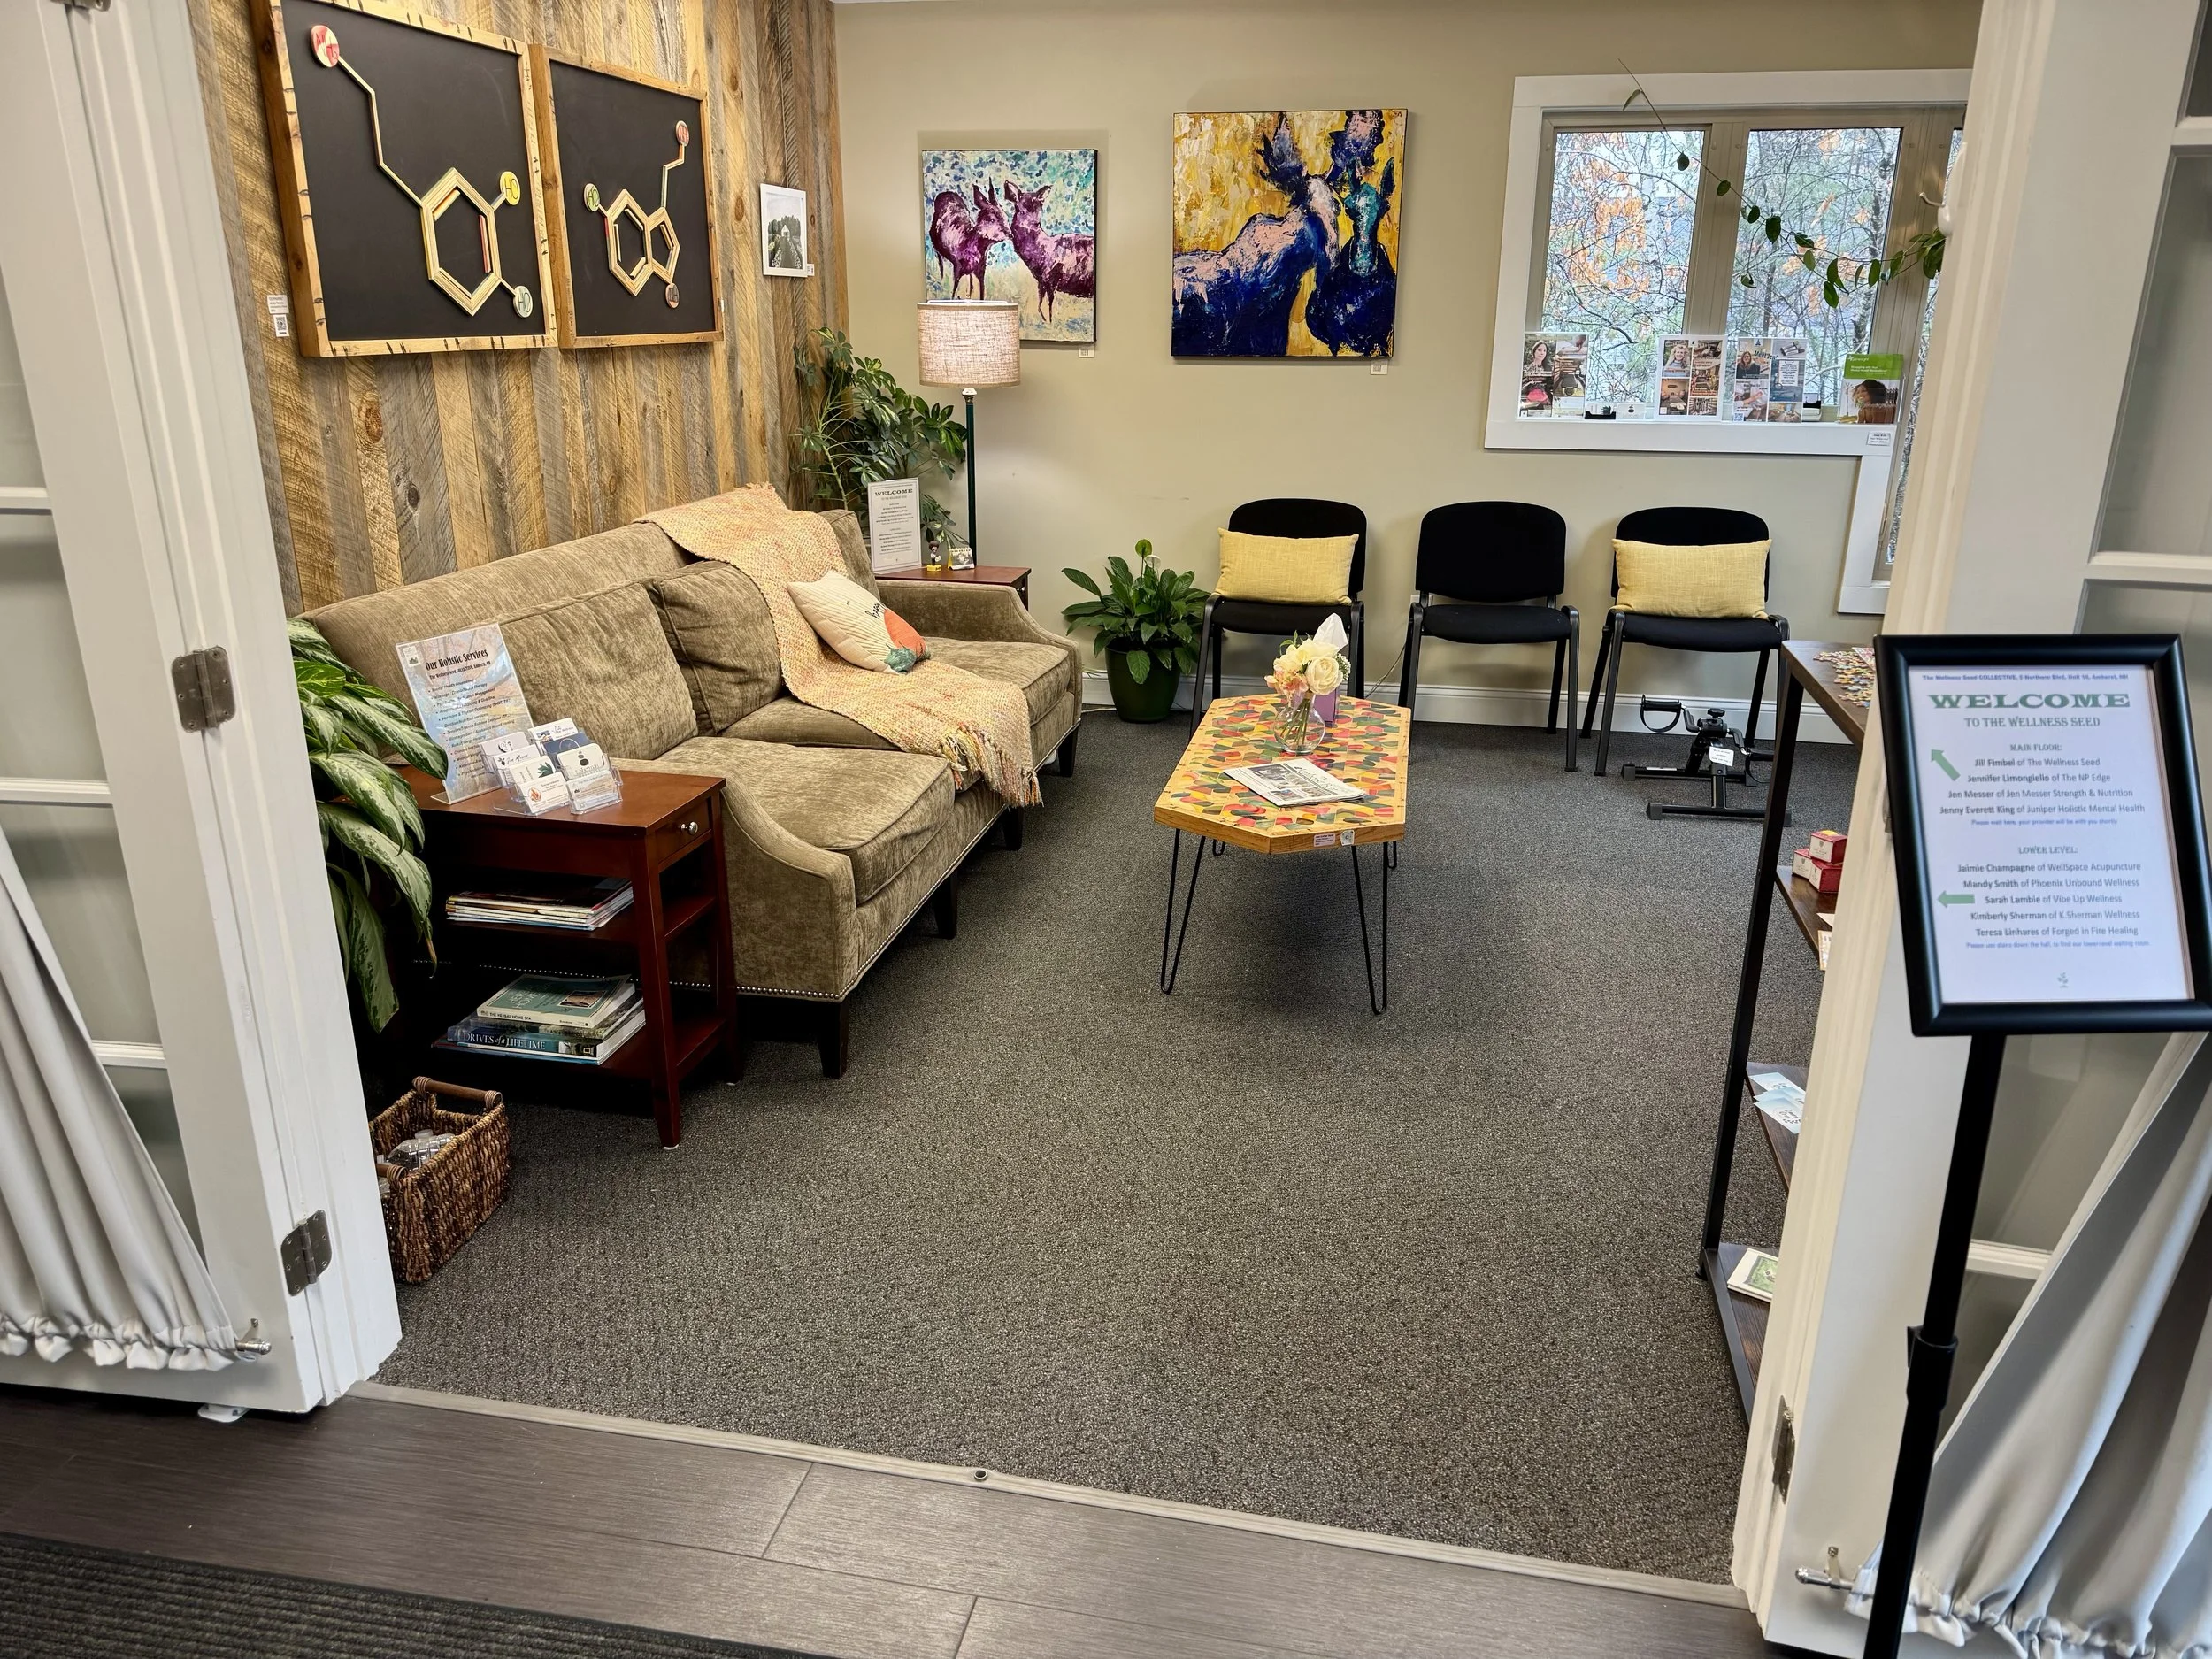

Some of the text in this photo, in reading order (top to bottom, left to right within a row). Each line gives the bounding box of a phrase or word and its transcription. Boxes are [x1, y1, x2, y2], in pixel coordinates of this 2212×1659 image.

[503, 176, 519, 199] HO
[517, 293, 531, 313] HO
[425, 649, 488, 671] Our Holistic Services
[1926, 693, 2131, 709] WELCOME
[1963, 716, 2101, 727] TO THE WELLNESS SEED
[2033, 743, 2062, 752] FLOOR:
[2044, 757, 2079, 766] Wellness
[2081, 757, 2101, 766] Seed
[2002, 773, 2050, 784] Limongiello
[2062, 773, 2077, 782] The
[2092, 773, 2111, 783] Edge
[1996, 789, 2005, 798] of
[2022, 789, 2051, 798] Messer
[2053, 789, 2087, 799] Strength
[1939, 806, 1963, 816] Jenny
[1997, 805, 2016, 815] King
[2017, 805, 2025, 814] of
[2027, 805, 2056, 815] Juniper
[2058, 804, 2087, 813] Holistic
[2089, 804, 2117, 813] Mental
[2119, 803, 2145, 812] Health
[2018, 846, 2047, 855] LOWER
[1957, 864, 1985, 872] Jaimie
[1986, 864, 2035, 873] Champagne
[2047, 864, 2088, 872] WellSpace
[2091, 862, 2141, 872] Acupuncture
[1963, 879, 1993, 889] Mandy
[1994, 879, 2019, 888] Smith
[2065, 878, 2102, 887] Unbound
[2104, 878, 2139, 887] Wellness
[1985, 895, 2009, 904] Sarah
[2072, 895, 2085, 904] Up
[2086, 894, 2123, 902] Wellness
[1970, 911, 2008, 922] Kimberly
[2009, 911, 2047, 920] Sherman
[2104, 910, 2139, 918] Wellness
[2004, 927, 2039, 936] Linhares
[2052, 927, 2079, 936] Forged
[2108, 926, 2139, 936] Healing
[463, 1032, 495, 1044] DRIVES
[506, 1037, 546, 1050] LIFETIME
